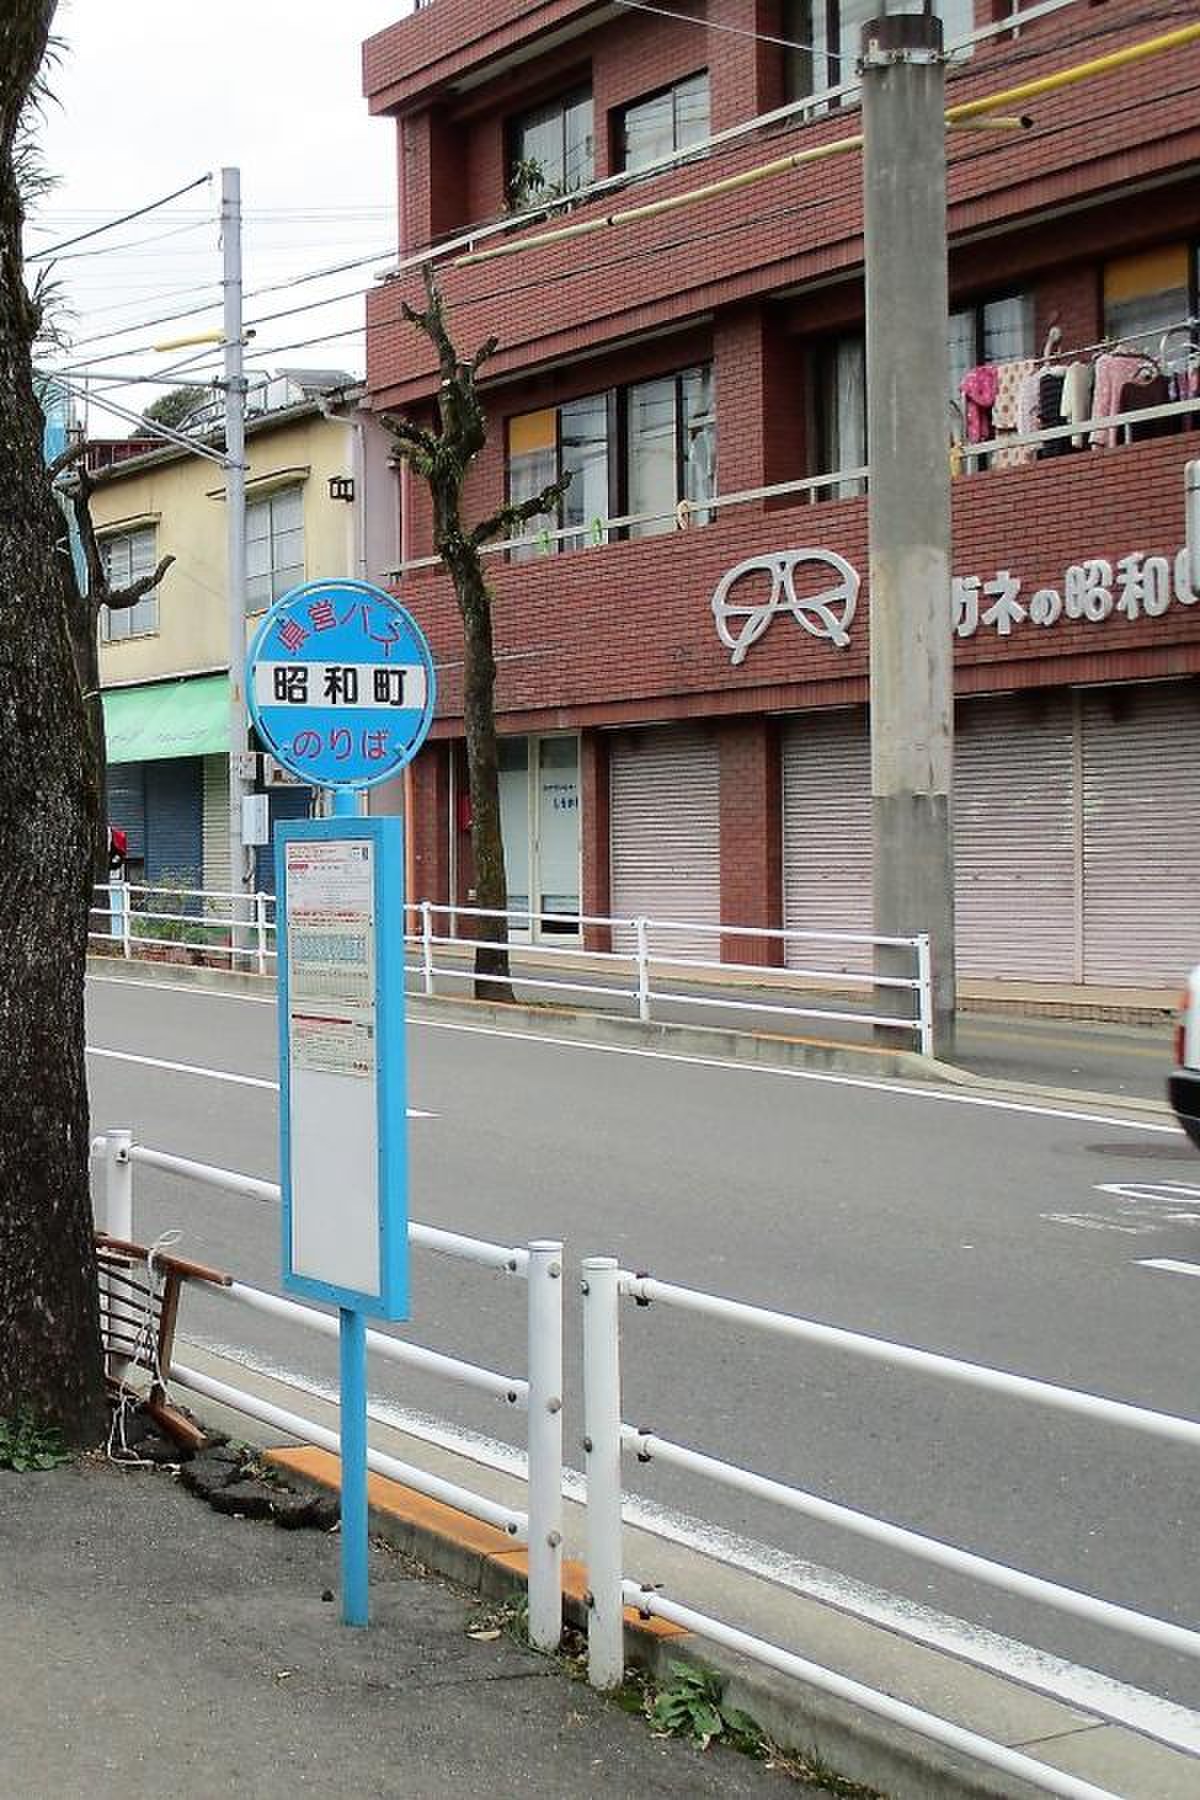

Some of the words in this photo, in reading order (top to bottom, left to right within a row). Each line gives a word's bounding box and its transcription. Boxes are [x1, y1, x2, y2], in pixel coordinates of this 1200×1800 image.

[277, 599, 400, 657] 県営バス
[273, 666, 407, 706] 昭和町
[293, 728, 388, 761] のりば
